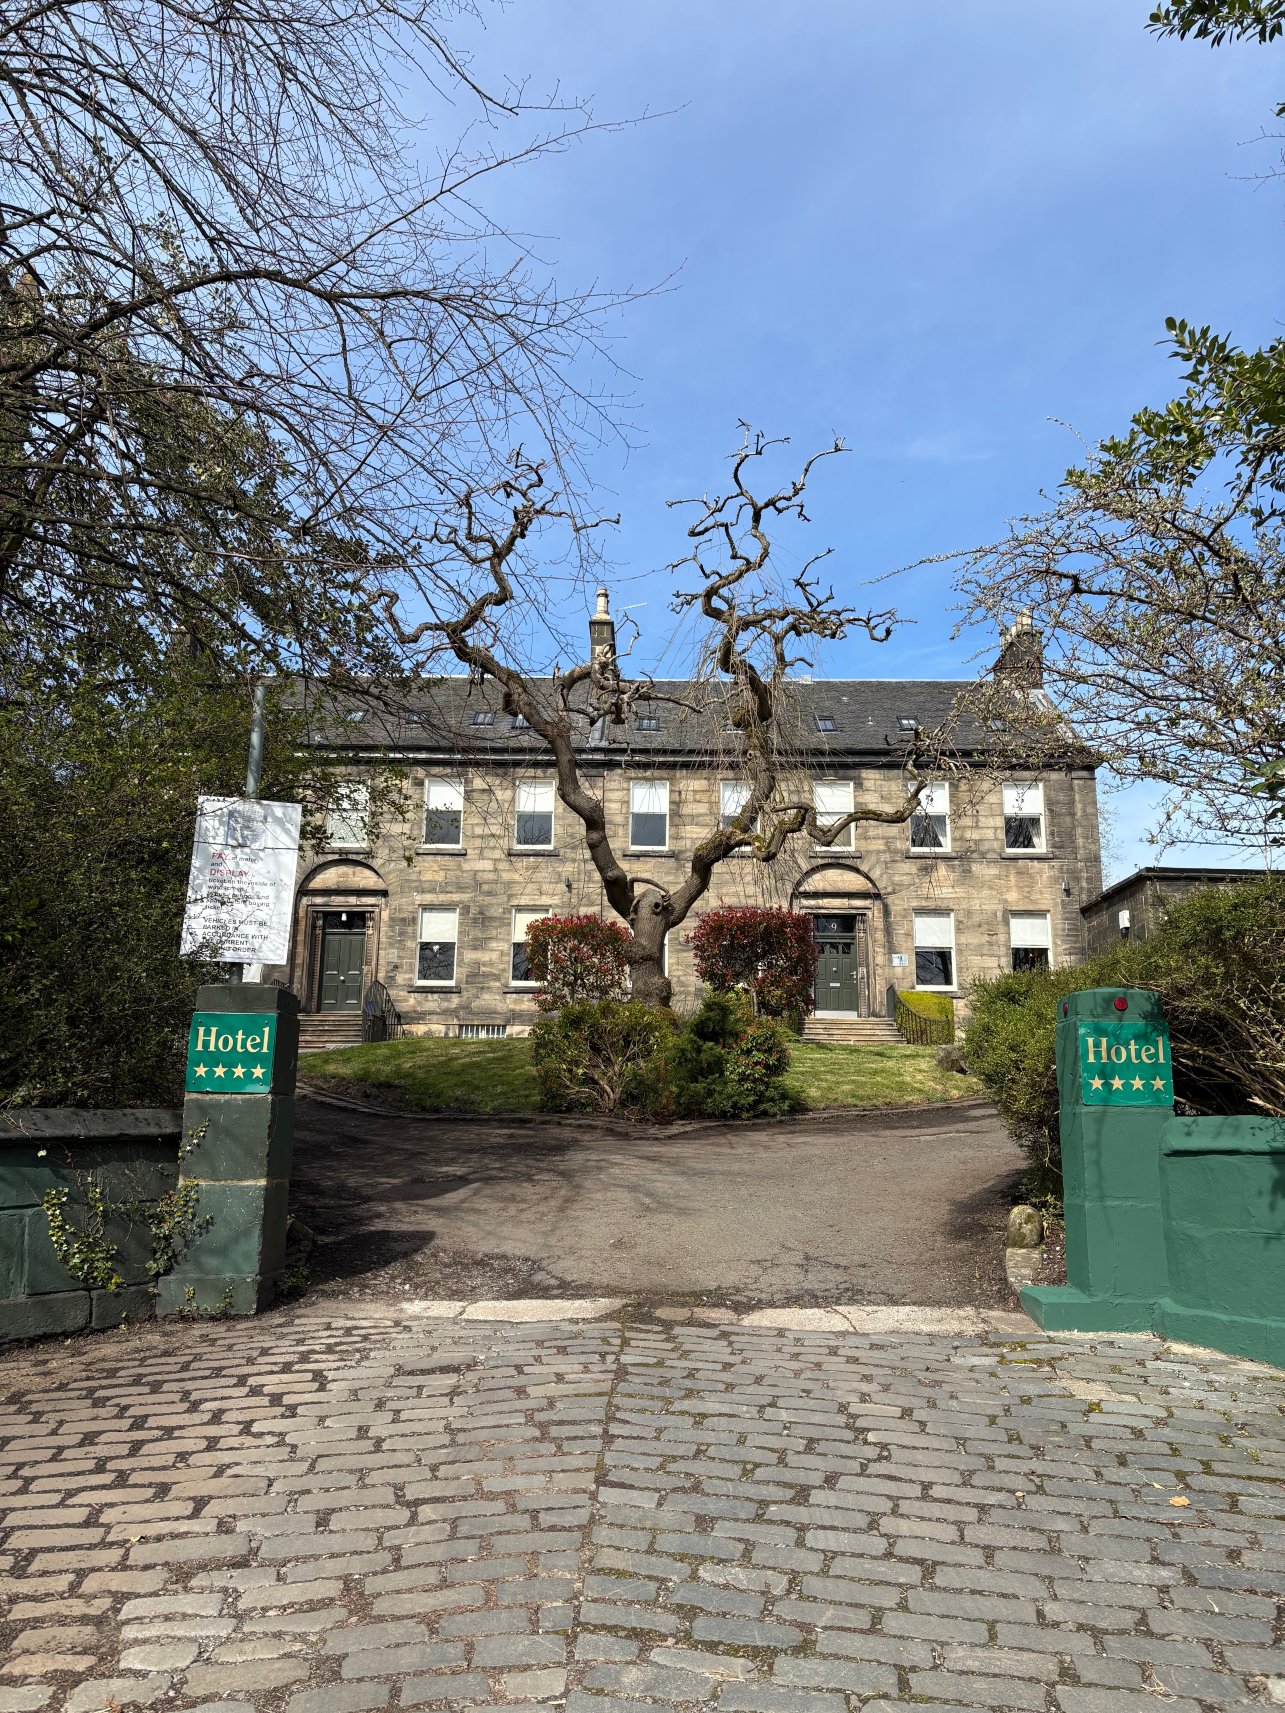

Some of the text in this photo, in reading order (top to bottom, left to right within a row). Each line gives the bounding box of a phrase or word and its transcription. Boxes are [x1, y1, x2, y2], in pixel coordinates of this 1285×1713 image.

[212, 852, 229, 860] PAY
[210, 868, 250, 877] DISPLAY
[202, 918, 237, 926] VEHICLES
[831, 922, 837, 931] 9
[202, 931, 250, 940] ACCORDANCE
[195, 1026, 270, 1053] Hotel
[1086, 1036, 1166, 1064] Hotel
